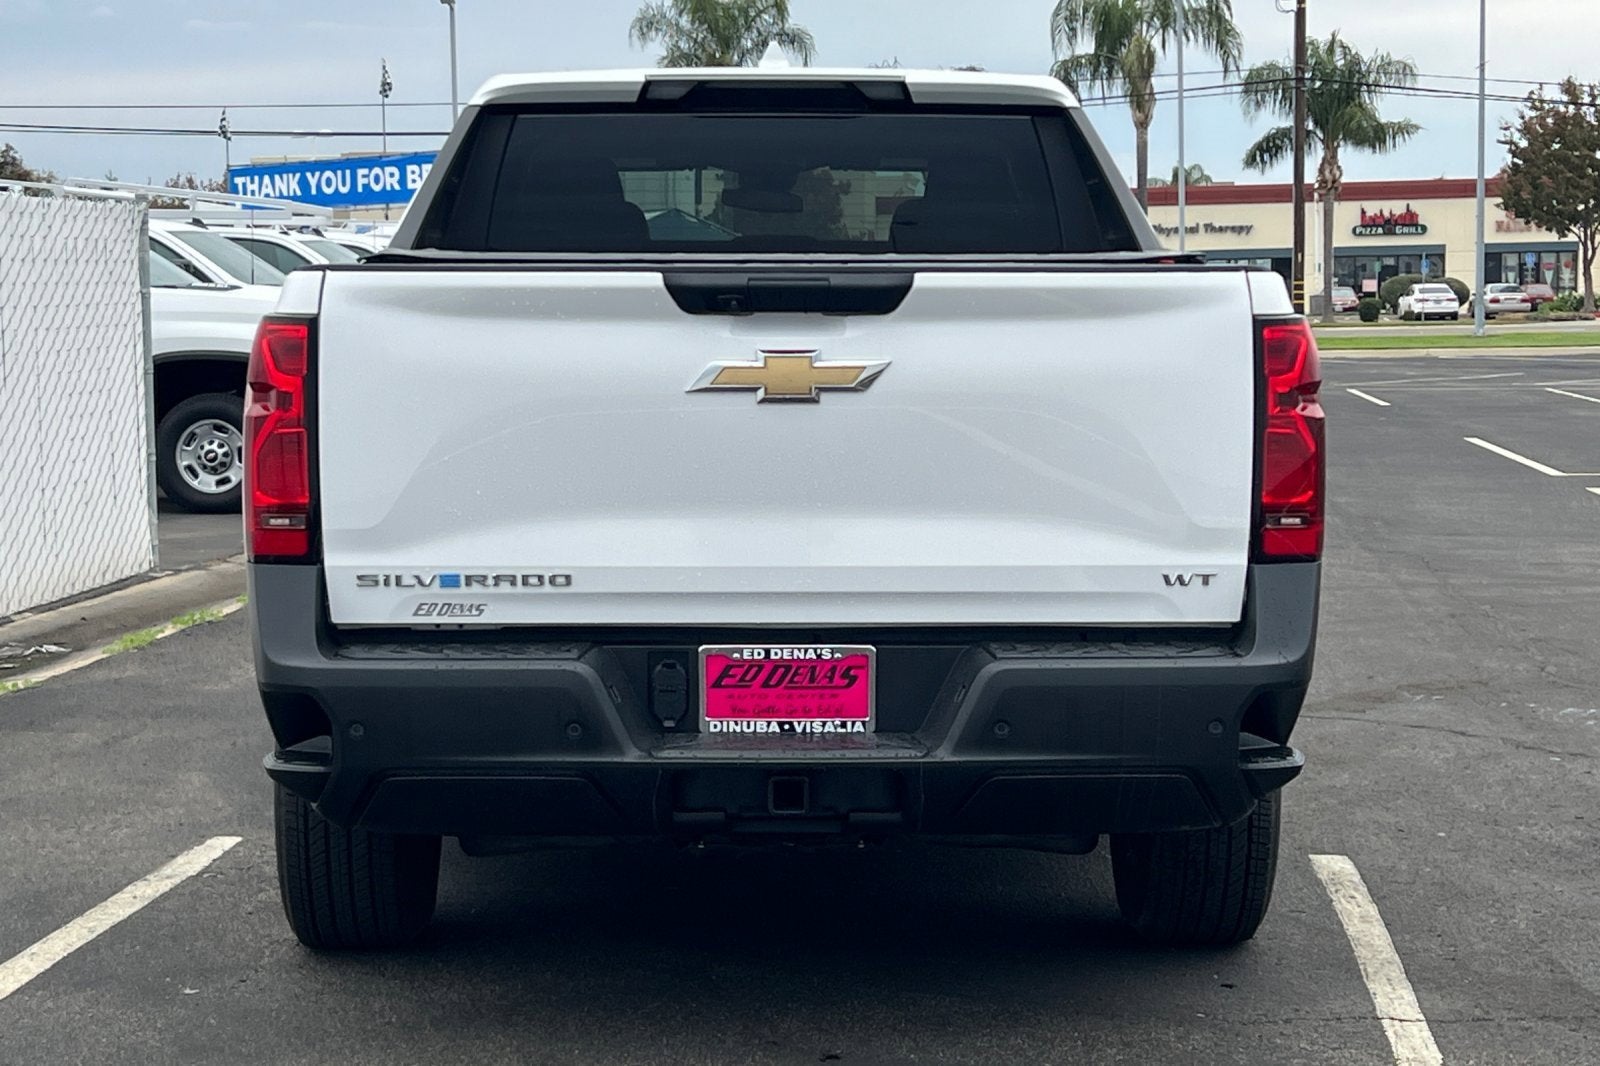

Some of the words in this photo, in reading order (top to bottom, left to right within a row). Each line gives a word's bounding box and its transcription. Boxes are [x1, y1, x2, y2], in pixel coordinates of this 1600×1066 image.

[234, 172, 302, 198] THANK
[305, 169, 350, 195] YOU
[356, 166, 401, 193] FOR
[1152, 222, 1200, 237] hyscal
[1203, 222, 1253, 236] Therapy
[1355, 226, 1384, 235] PIZZA
[1395, 225, 1423, 235] GRILL
[356, 574, 573, 588] SILVERADO
[1162, 573, 1218, 587] WT
[412, 602, 438, 617] ED
[743, 648, 765, 660] ED
[770, 648, 833, 660] DENA'S
[711, 664, 764, 688] ED
[709, 721, 780, 733] DINUBA
[794, 721, 865, 733] VISALIA
